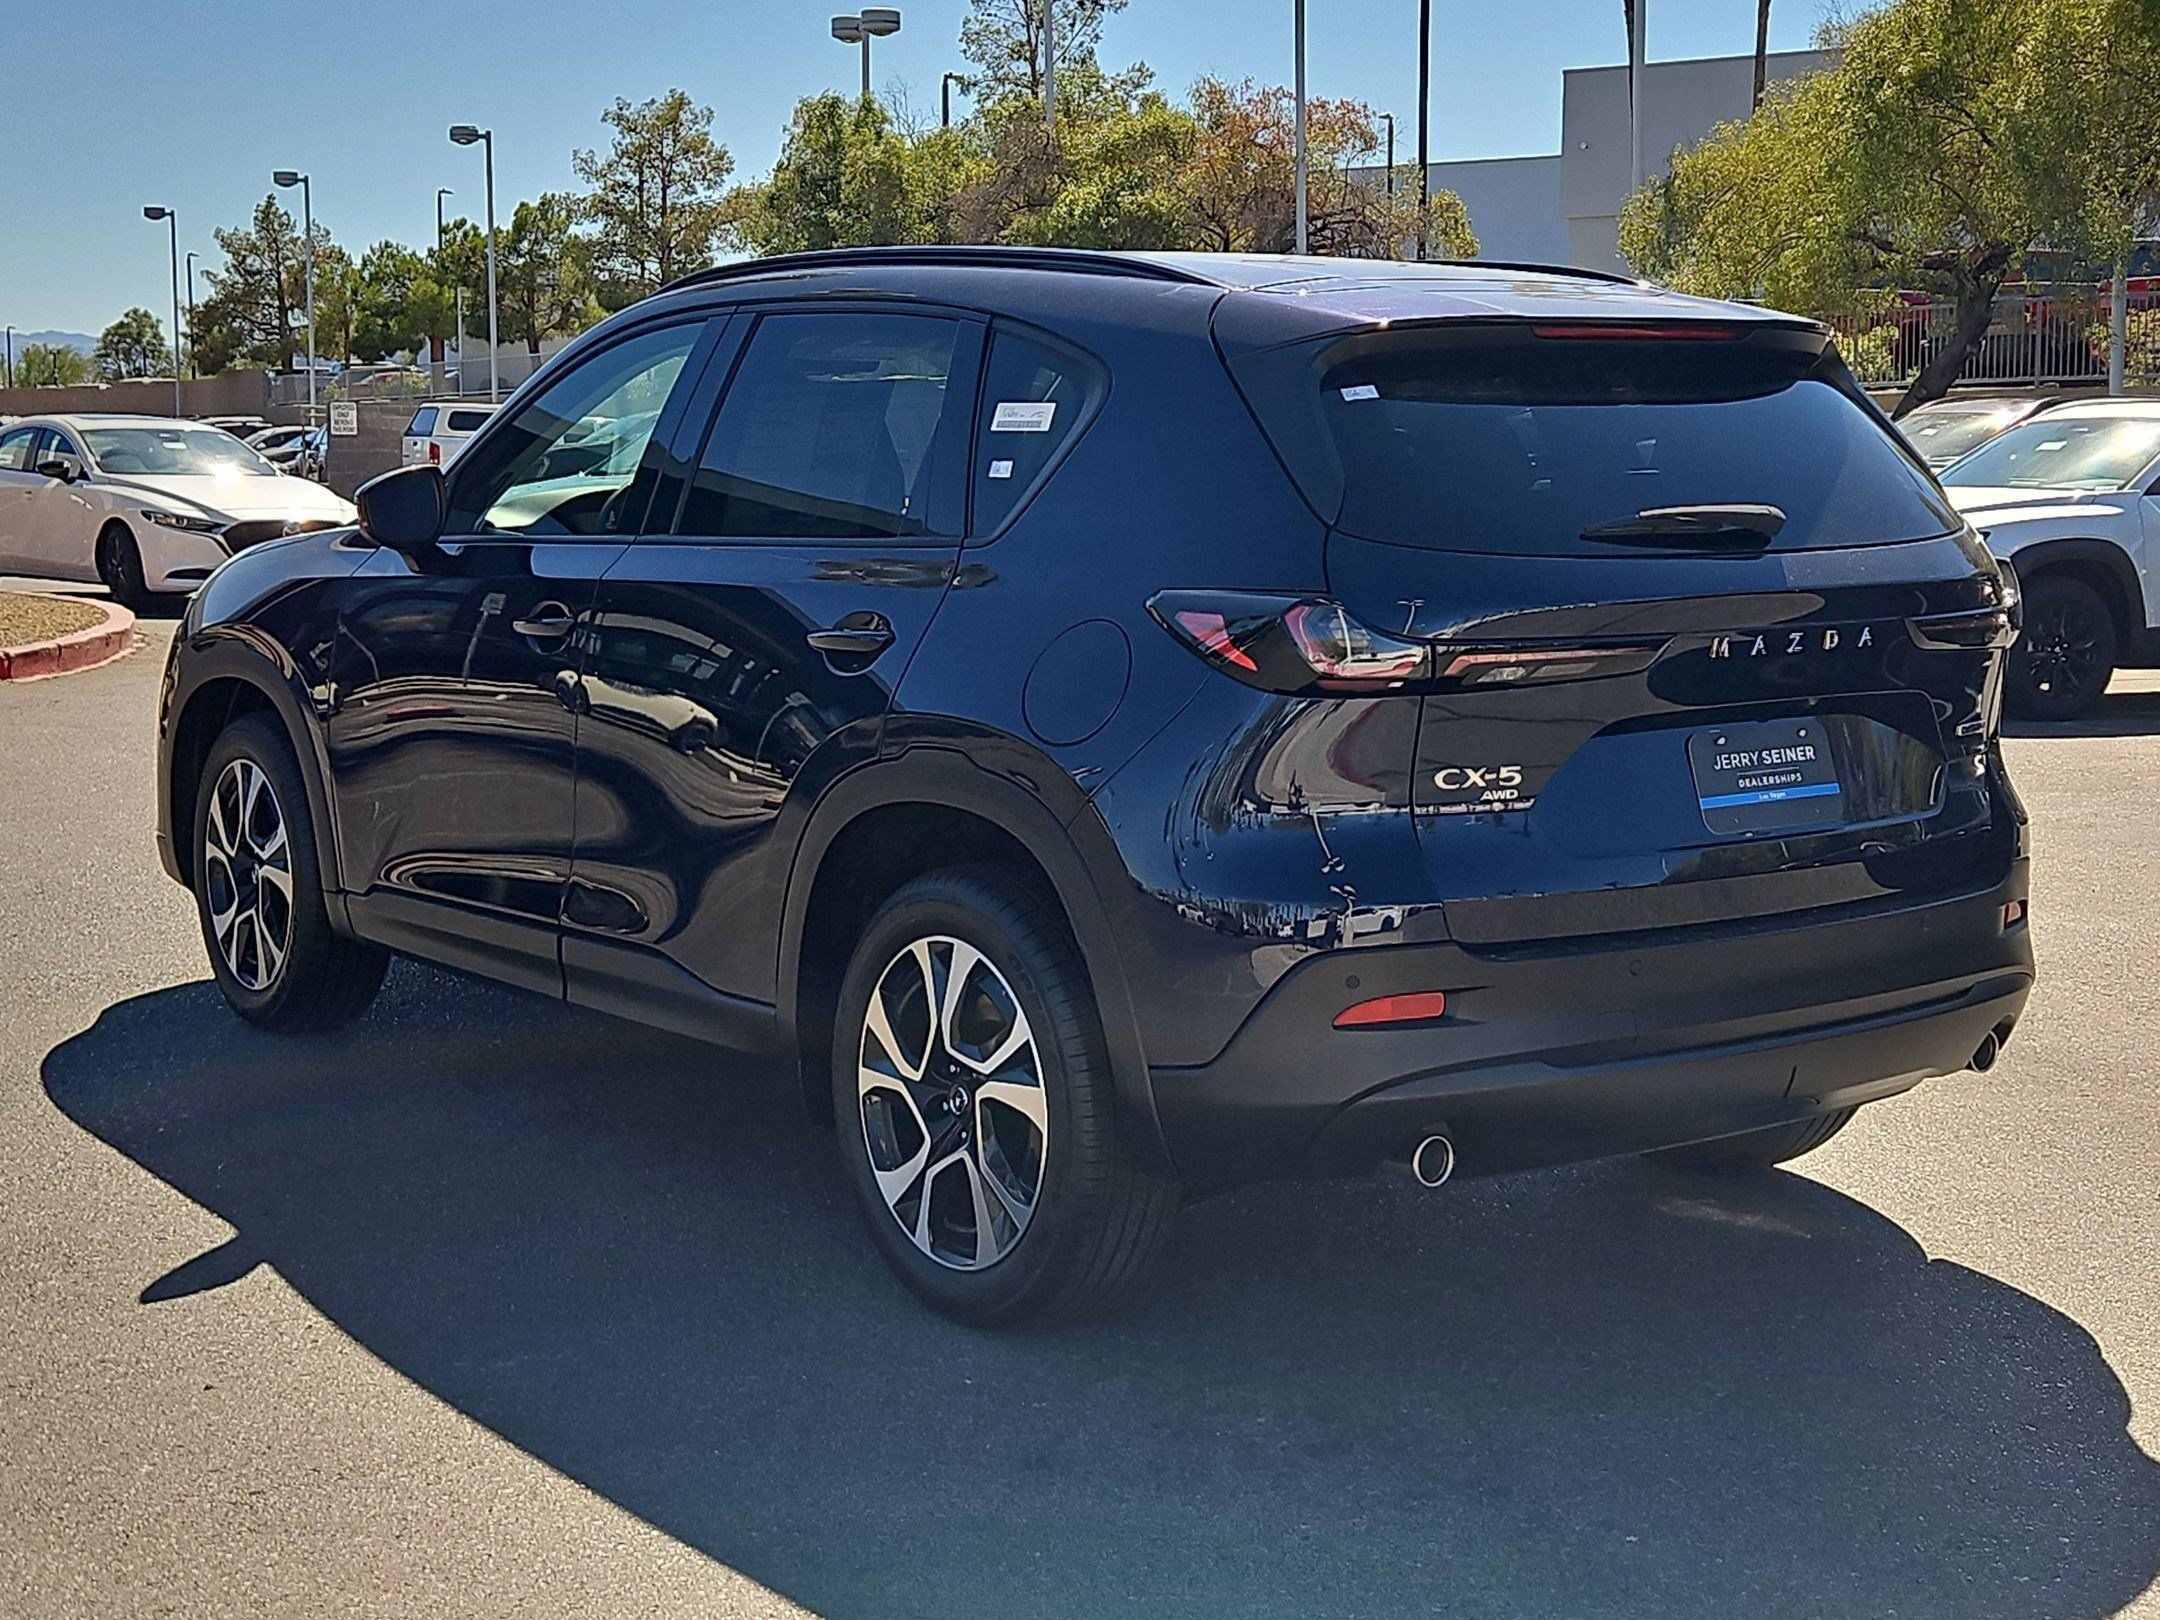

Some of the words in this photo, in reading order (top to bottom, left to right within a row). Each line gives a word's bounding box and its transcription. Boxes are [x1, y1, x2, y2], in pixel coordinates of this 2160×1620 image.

[1709, 627, 1873, 658] MAZDA
[1713, 751, 1760, 770] JERRY
[1761, 745, 1817, 765] SEINER
[1433, 765, 1522, 789] CX-5
[1738, 772, 1803, 788] DEALERSHIPS
[1480, 789, 1519, 801] AWD
